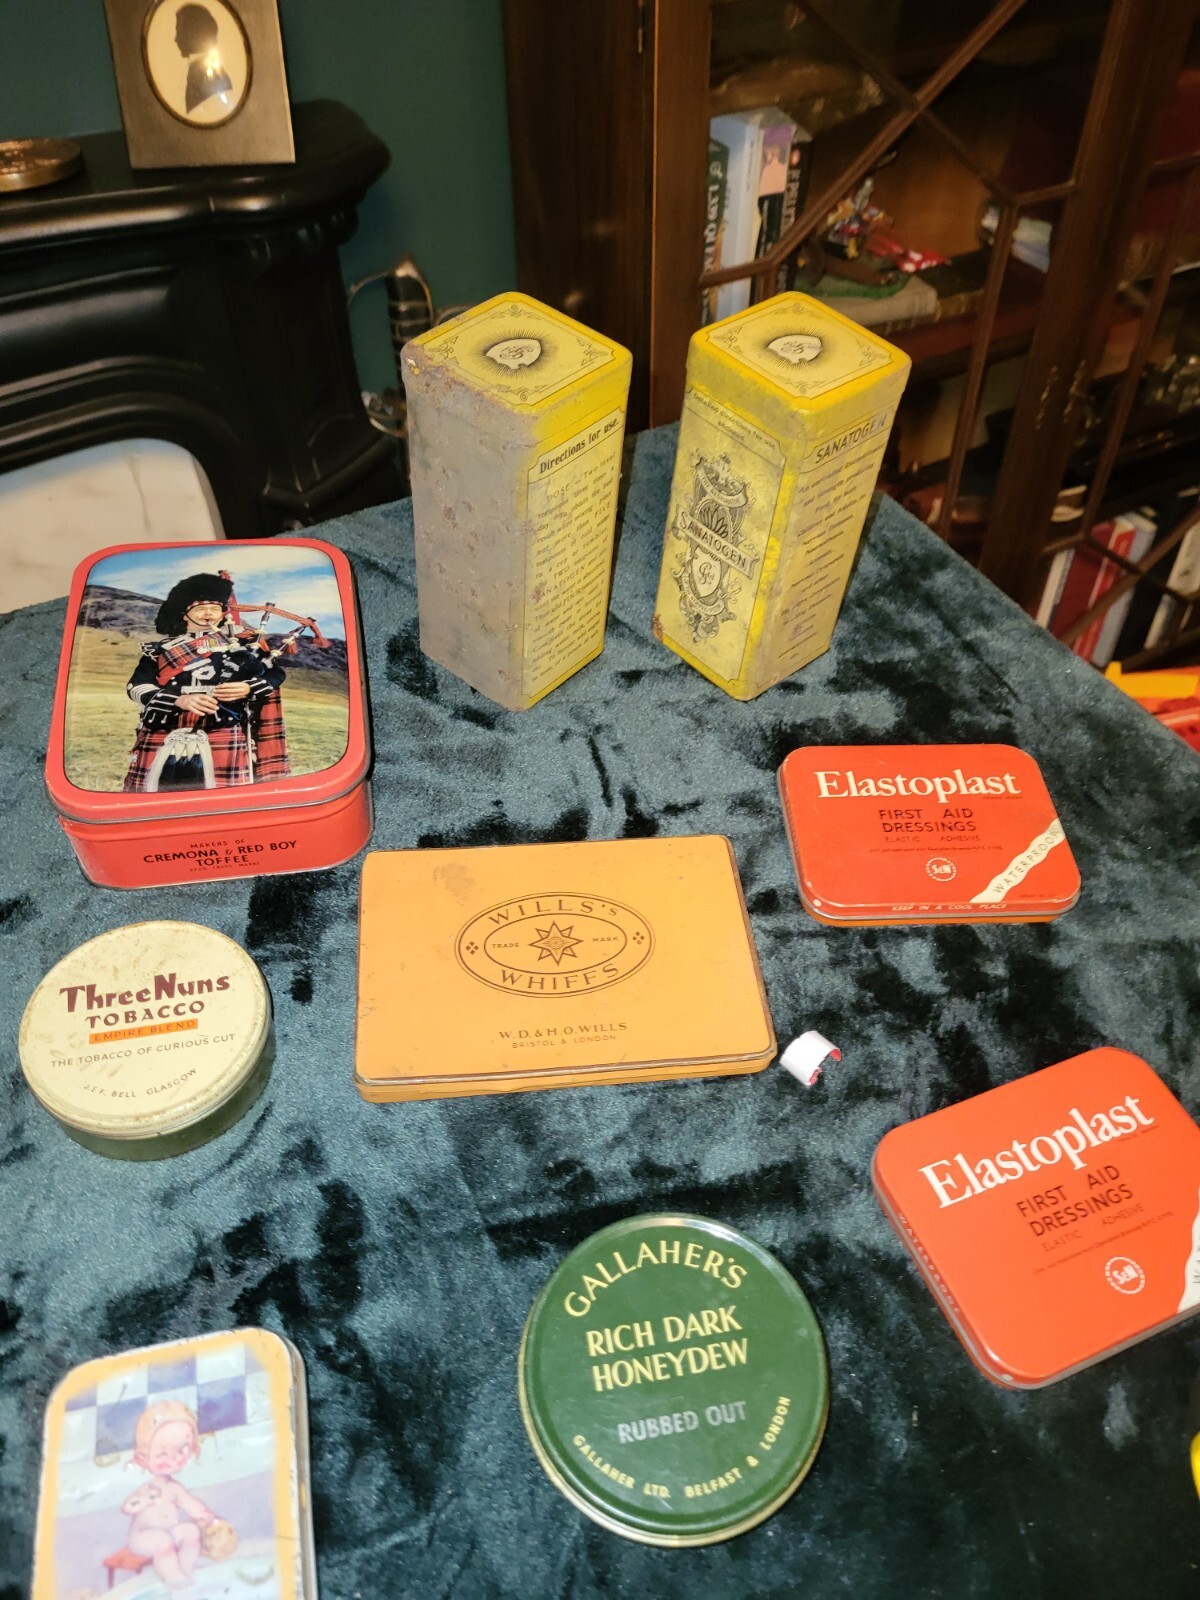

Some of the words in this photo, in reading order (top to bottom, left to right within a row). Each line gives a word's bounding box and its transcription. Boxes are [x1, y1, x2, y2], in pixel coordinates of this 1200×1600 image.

[540, 439, 587, 475] Directions
[588, 429, 602, 445] for
[815, 412, 889, 465] SANATOGEN
[679, 509, 748, 569] SANATOGEN
[813, 768, 1022, 804] Elastoplast
[878, 808, 923, 820] FIRST
[942, 807, 974, 819] AID
[882, 821, 977, 833] DRESSINGS
[143, 848, 219, 863] CREMONA
[238, 843, 264, 854] RED
[270, 840, 297, 851] BOY
[190, 840, 229, 849] MAKERS
[195, 854, 251, 867] TOFFEE
[501, 962, 620, 991] WHIFFS
[86, 1000, 206, 1029] TOBACCO
[94, 1027, 145, 1042] EMPIRE
[149, 1019, 196, 1035] BLEND
[51, 1058, 74, 1069] THE
[78, 1049, 133, 1065] TOBACCO
[137, 1046, 153, 1056] OF
[156, 1036, 210, 1053] CURIOUS
[213, 1033, 236, 1044] CUT
[512, 1039, 556, 1049] BRISTOL
[573, 1034, 617, 1044] LONDON
[111, 1089, 137, 1099] BELL
[146, 1067, 198, 1096] GLASGOW
[918, 1094, 1155, 1209] Elastoplast
[1015, 1184, 1068, 1218] FIRST
[1086, 1164, 1121, 1191] AID
[1029, 1182, 1134, 1238] DRESSINGS
[563, 1239, 748, 1318] GALLAHER'S
[585, 1320, 656, 1358] RICH
[662, 1305, 744, 1343] DARK
[591, 1337, 749, 1393] HONEYDEW
[617, 1410, 700, 1444] RUBBED
[706, 1400, 748, 1425] OUT
[572, 1434, 637, 1490] GALLAHER
[684, 1466, 744, 1499] BELFAST
[760, 1395, 792, 1452] LONDON
